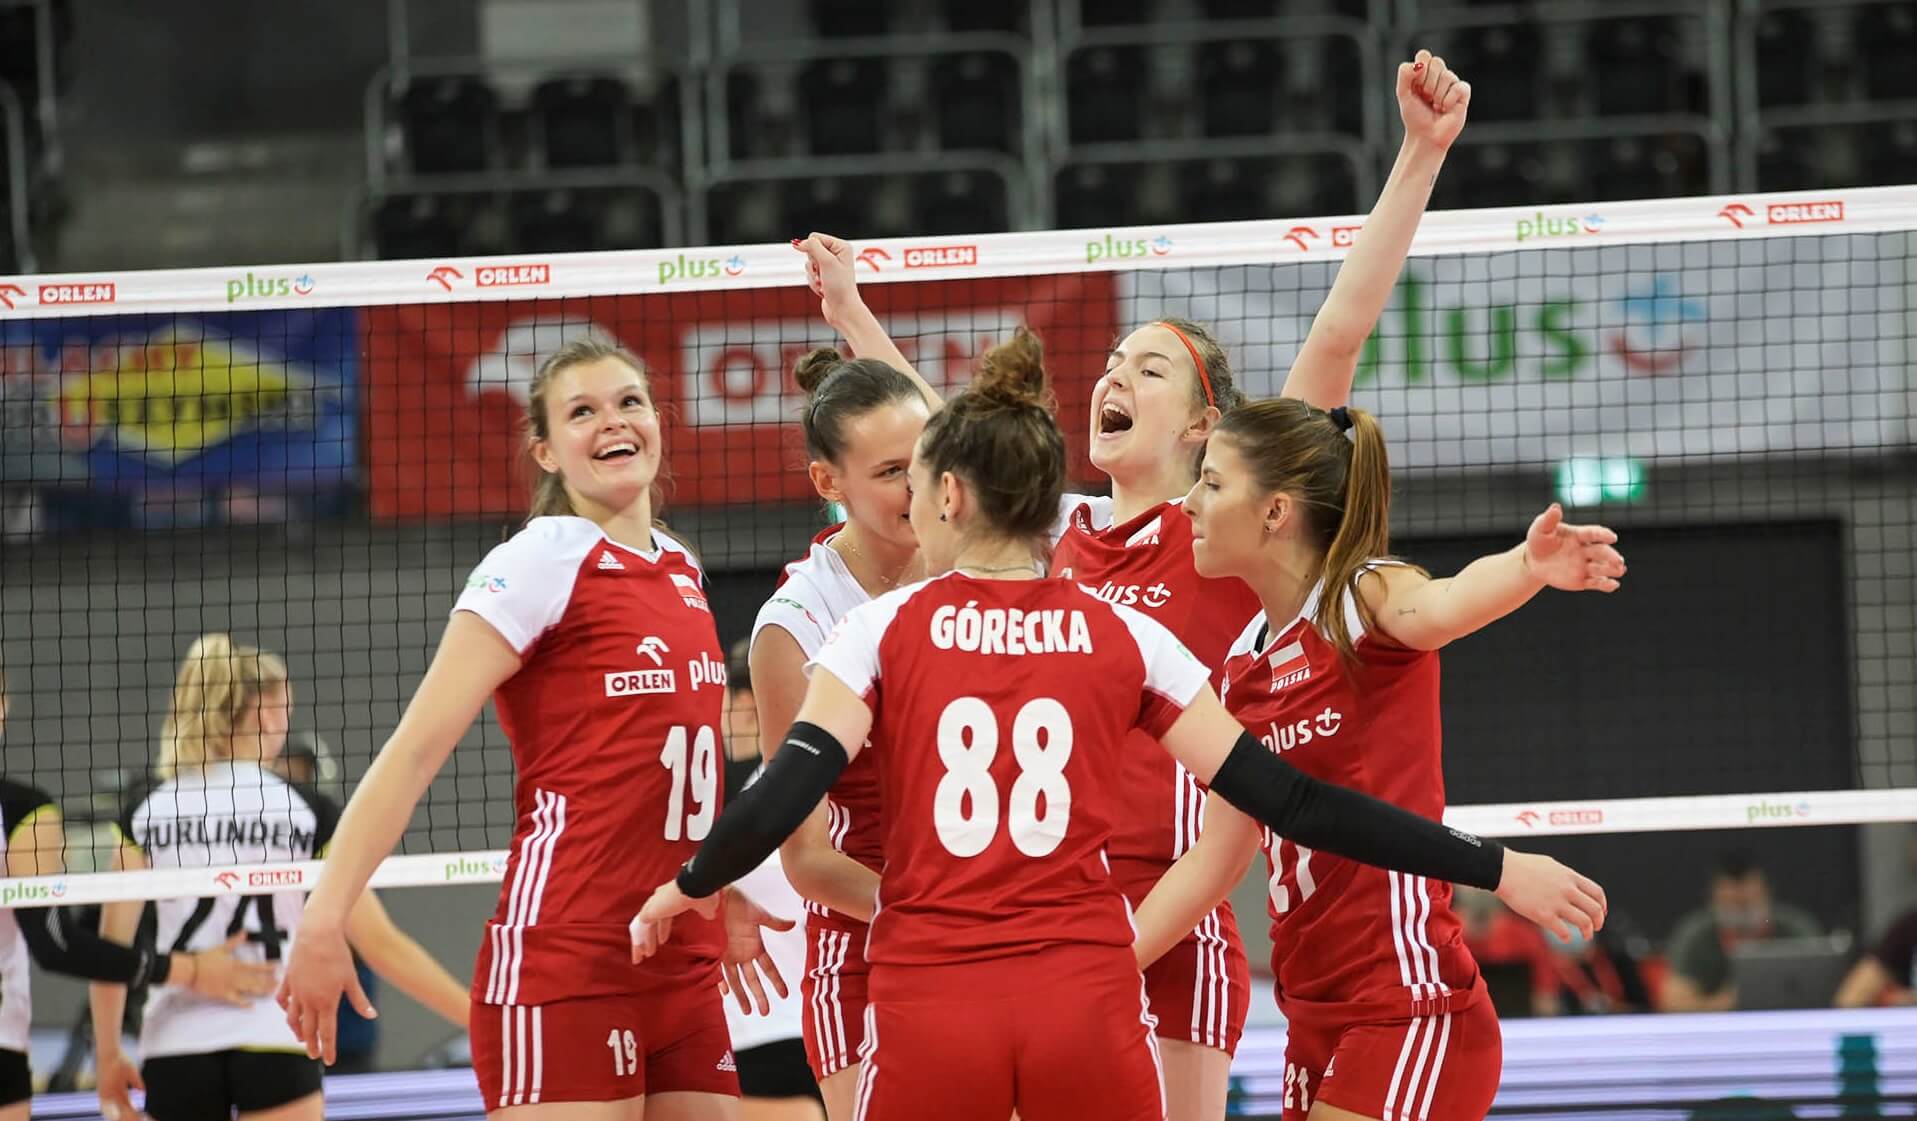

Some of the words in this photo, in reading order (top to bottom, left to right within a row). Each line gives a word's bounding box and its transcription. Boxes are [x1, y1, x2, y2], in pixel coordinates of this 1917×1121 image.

[1516, 212, 1579, 241] plus
[1771, 204, 1840, 223] ORLEN
[906, 247, 974, 267] ORLEN
[1086, 234, 1147, 263] plus
[477, 266, 548, 286] ORLEN
[658, 254, 721, 284] plus
[42, 285, 112, 304] ORLEN
[227, 272, 290, 303] plus
[930, 600, 1093, 655] GÓRECKA
[611, 673, 671, 692] ORLEN
[688, 651, 727, 691] plus
[1270, 668, 1311, 693] POLSKA
[660, 725, 717, 841] 19
[933, 696, 1074, 858] 88
[445, 857, 490, 881] plus
[3, 881, 49, 904] plus
[606, 1028, 637, 1076] 19
[1284, 1062, 1309, 1112] 21
